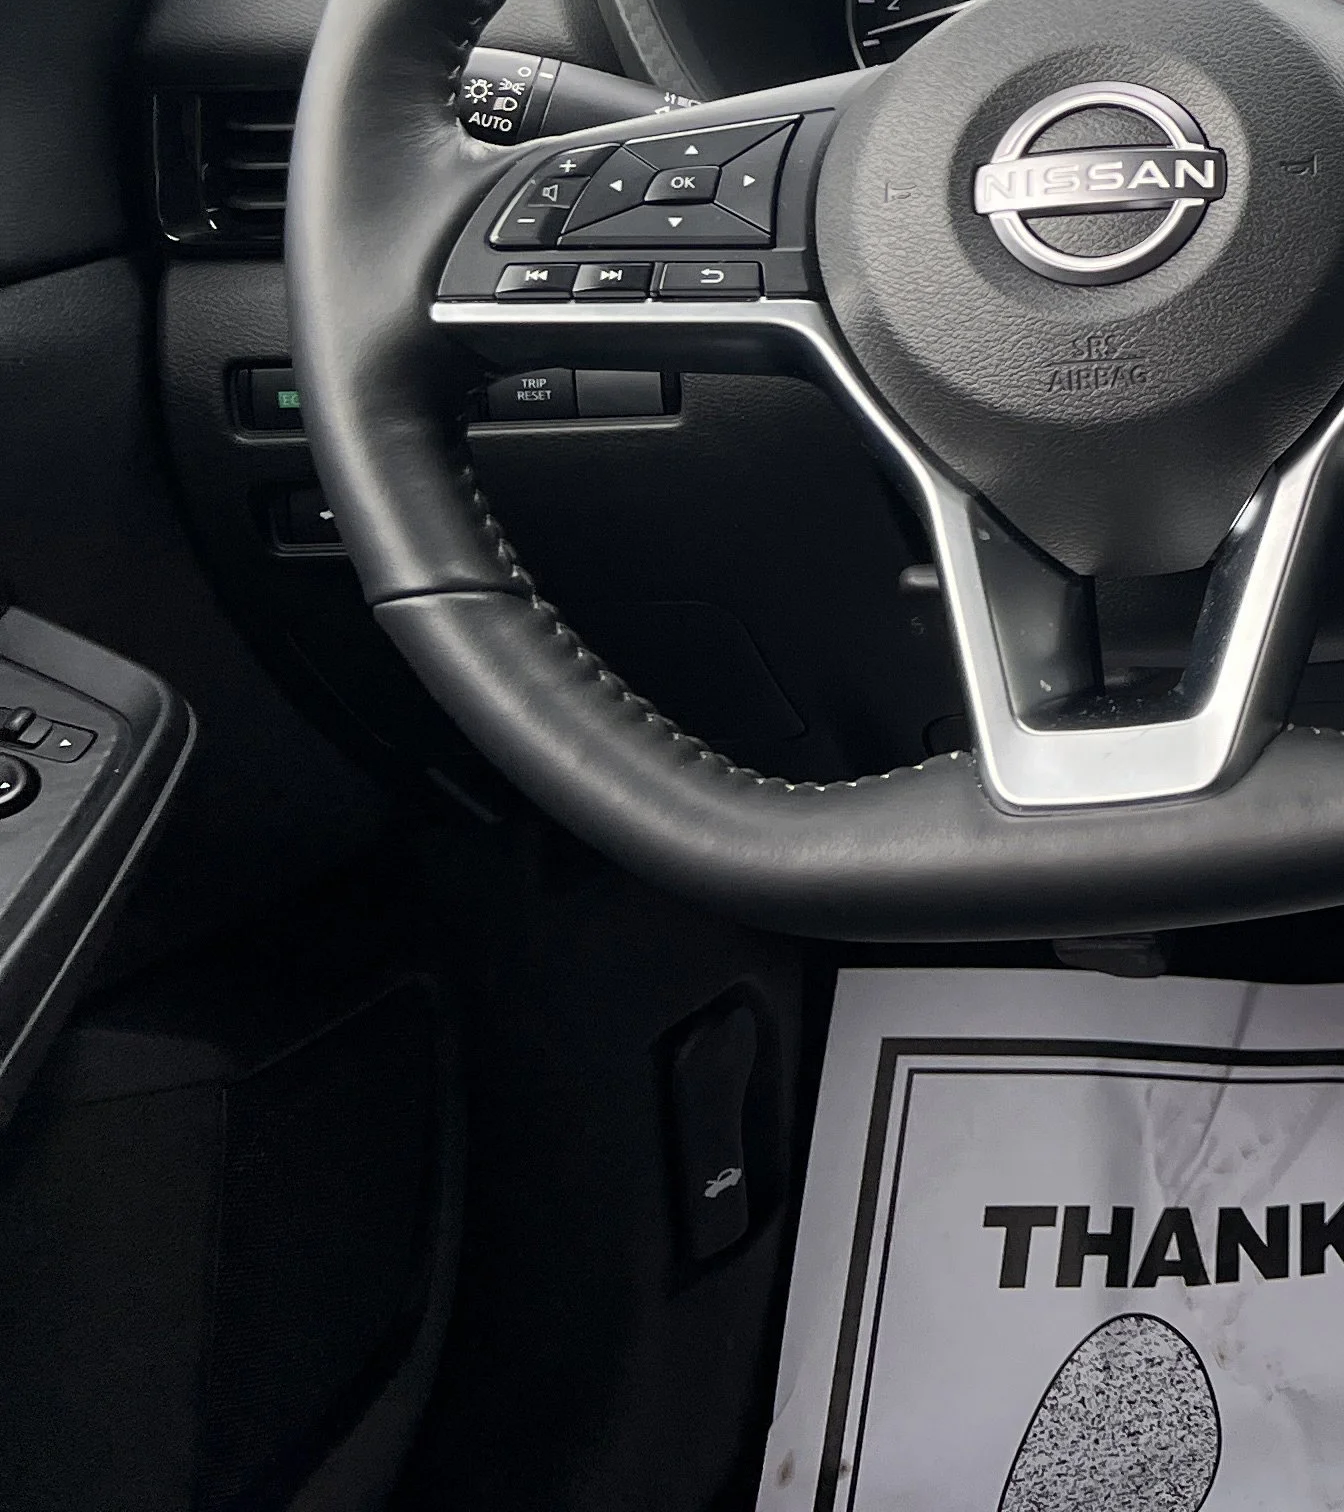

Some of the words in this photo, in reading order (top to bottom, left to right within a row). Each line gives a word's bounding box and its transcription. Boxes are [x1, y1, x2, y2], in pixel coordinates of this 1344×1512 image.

[468, 111, 513, 132] AUTO
[670, 176, 696, 189] OK
[983, 159, 1215, 202] NISSAN
[521, 378, 547, 389] TRIP
[1047, 365, 1148, 392] AIRBAG
[517, 389, 552, 402] RESET
